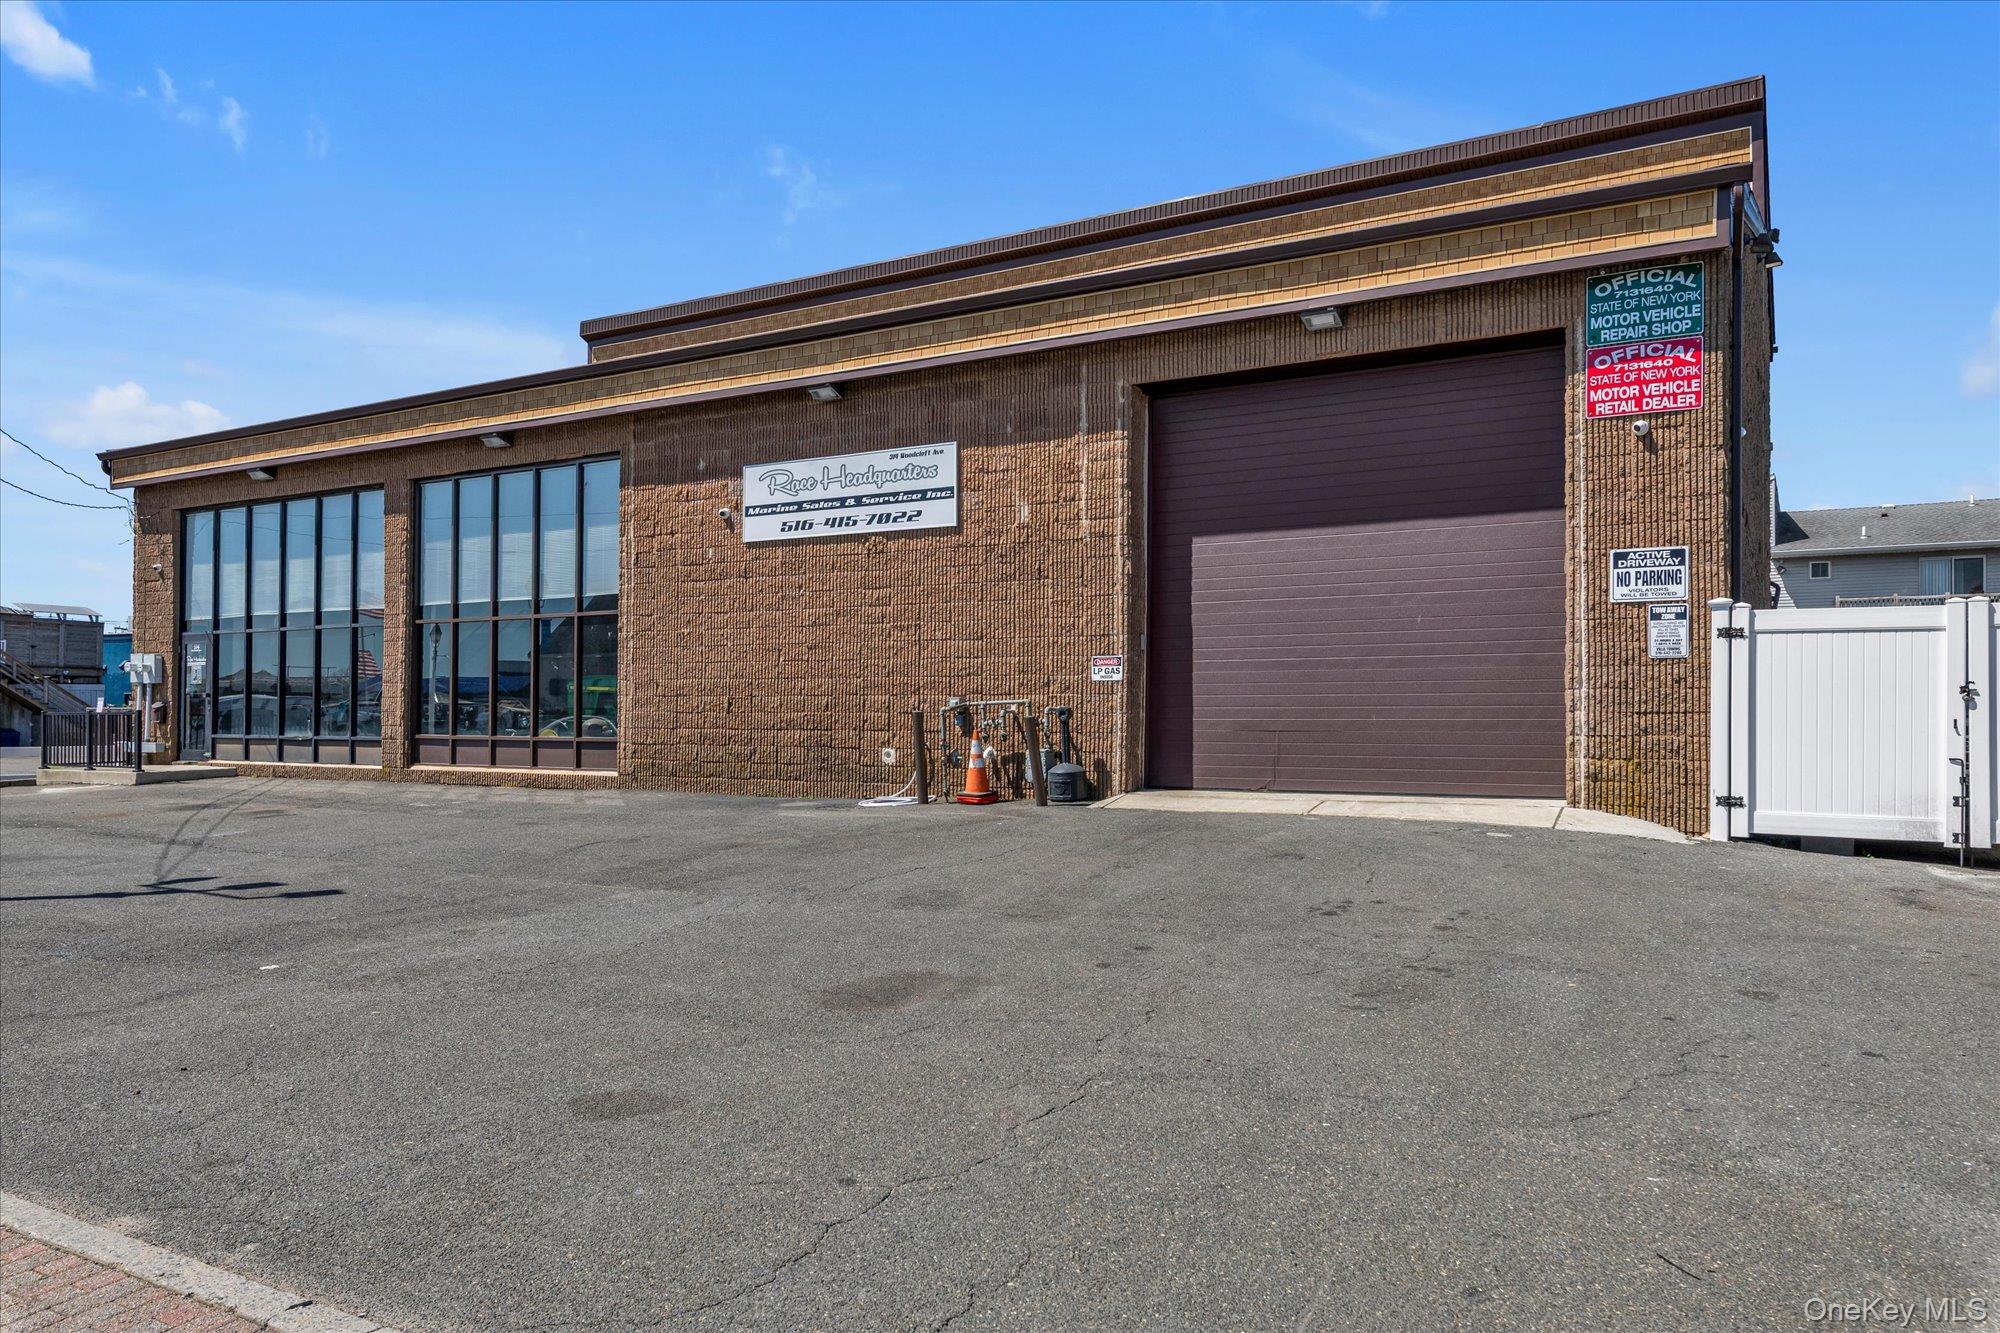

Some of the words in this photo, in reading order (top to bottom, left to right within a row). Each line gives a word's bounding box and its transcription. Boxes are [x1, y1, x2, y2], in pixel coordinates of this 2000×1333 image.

[1594, 269, 1697, 297] OFFICIAL
[1614, 284, 1674, 298] 7131640
[1590, 300, 1622, 314] STATE
[1624, 298, 1639, 310] OF
[1641, 294, 1668, 308] NEW
[1670, 290, 1701, 303] YORK
[1590, 312, 1640, 330] MOTOR
[1643, 304, 1701, 323] VEHICLE
[1601, 325, 1648, 342] REPAIR
[1652, 320, 1692, 336] SHOP
[1593, 343, 1697, 370] OFFICIAL
[1613, 358, 1674, 372] 7131640
[1590, 374, 1621, 387] STATE
[1623, 371, 1639, 383] OF
[1640, 368, 1668, 381] NEW
[1670, 365, 1701, 377] YORK
[1590, 385, 1639, 402] MOTOR
[1642, 379, 1700, 396] VEHICLE
[1595, 401, 1639, 415] RETAIL
[1642, 394, 1696, 411] DEALER
[759, 468, 817, 497] Race
[821, 463, 939, 490] Headquarters
[747, 503, 798, 516] Marine
[802, 500, 841, 511] Sales
[845, 498, 857, 507] &
[861, 492, 922, 505] Service
[926, 490, 954, 499] Inc.
[780, 509, 923, 533] 516-415-7022
[1618, 557, 1681, 568] DRIVEWAY
[1627, 550, 1671, 560] ACTIVE
[1616, 571, 1631, 587] NO
[1635, 569, 1682, 587] PARKING
[1652, 606, 1666, 614] TOW
[1104, 667, 1121, 675] GAS
